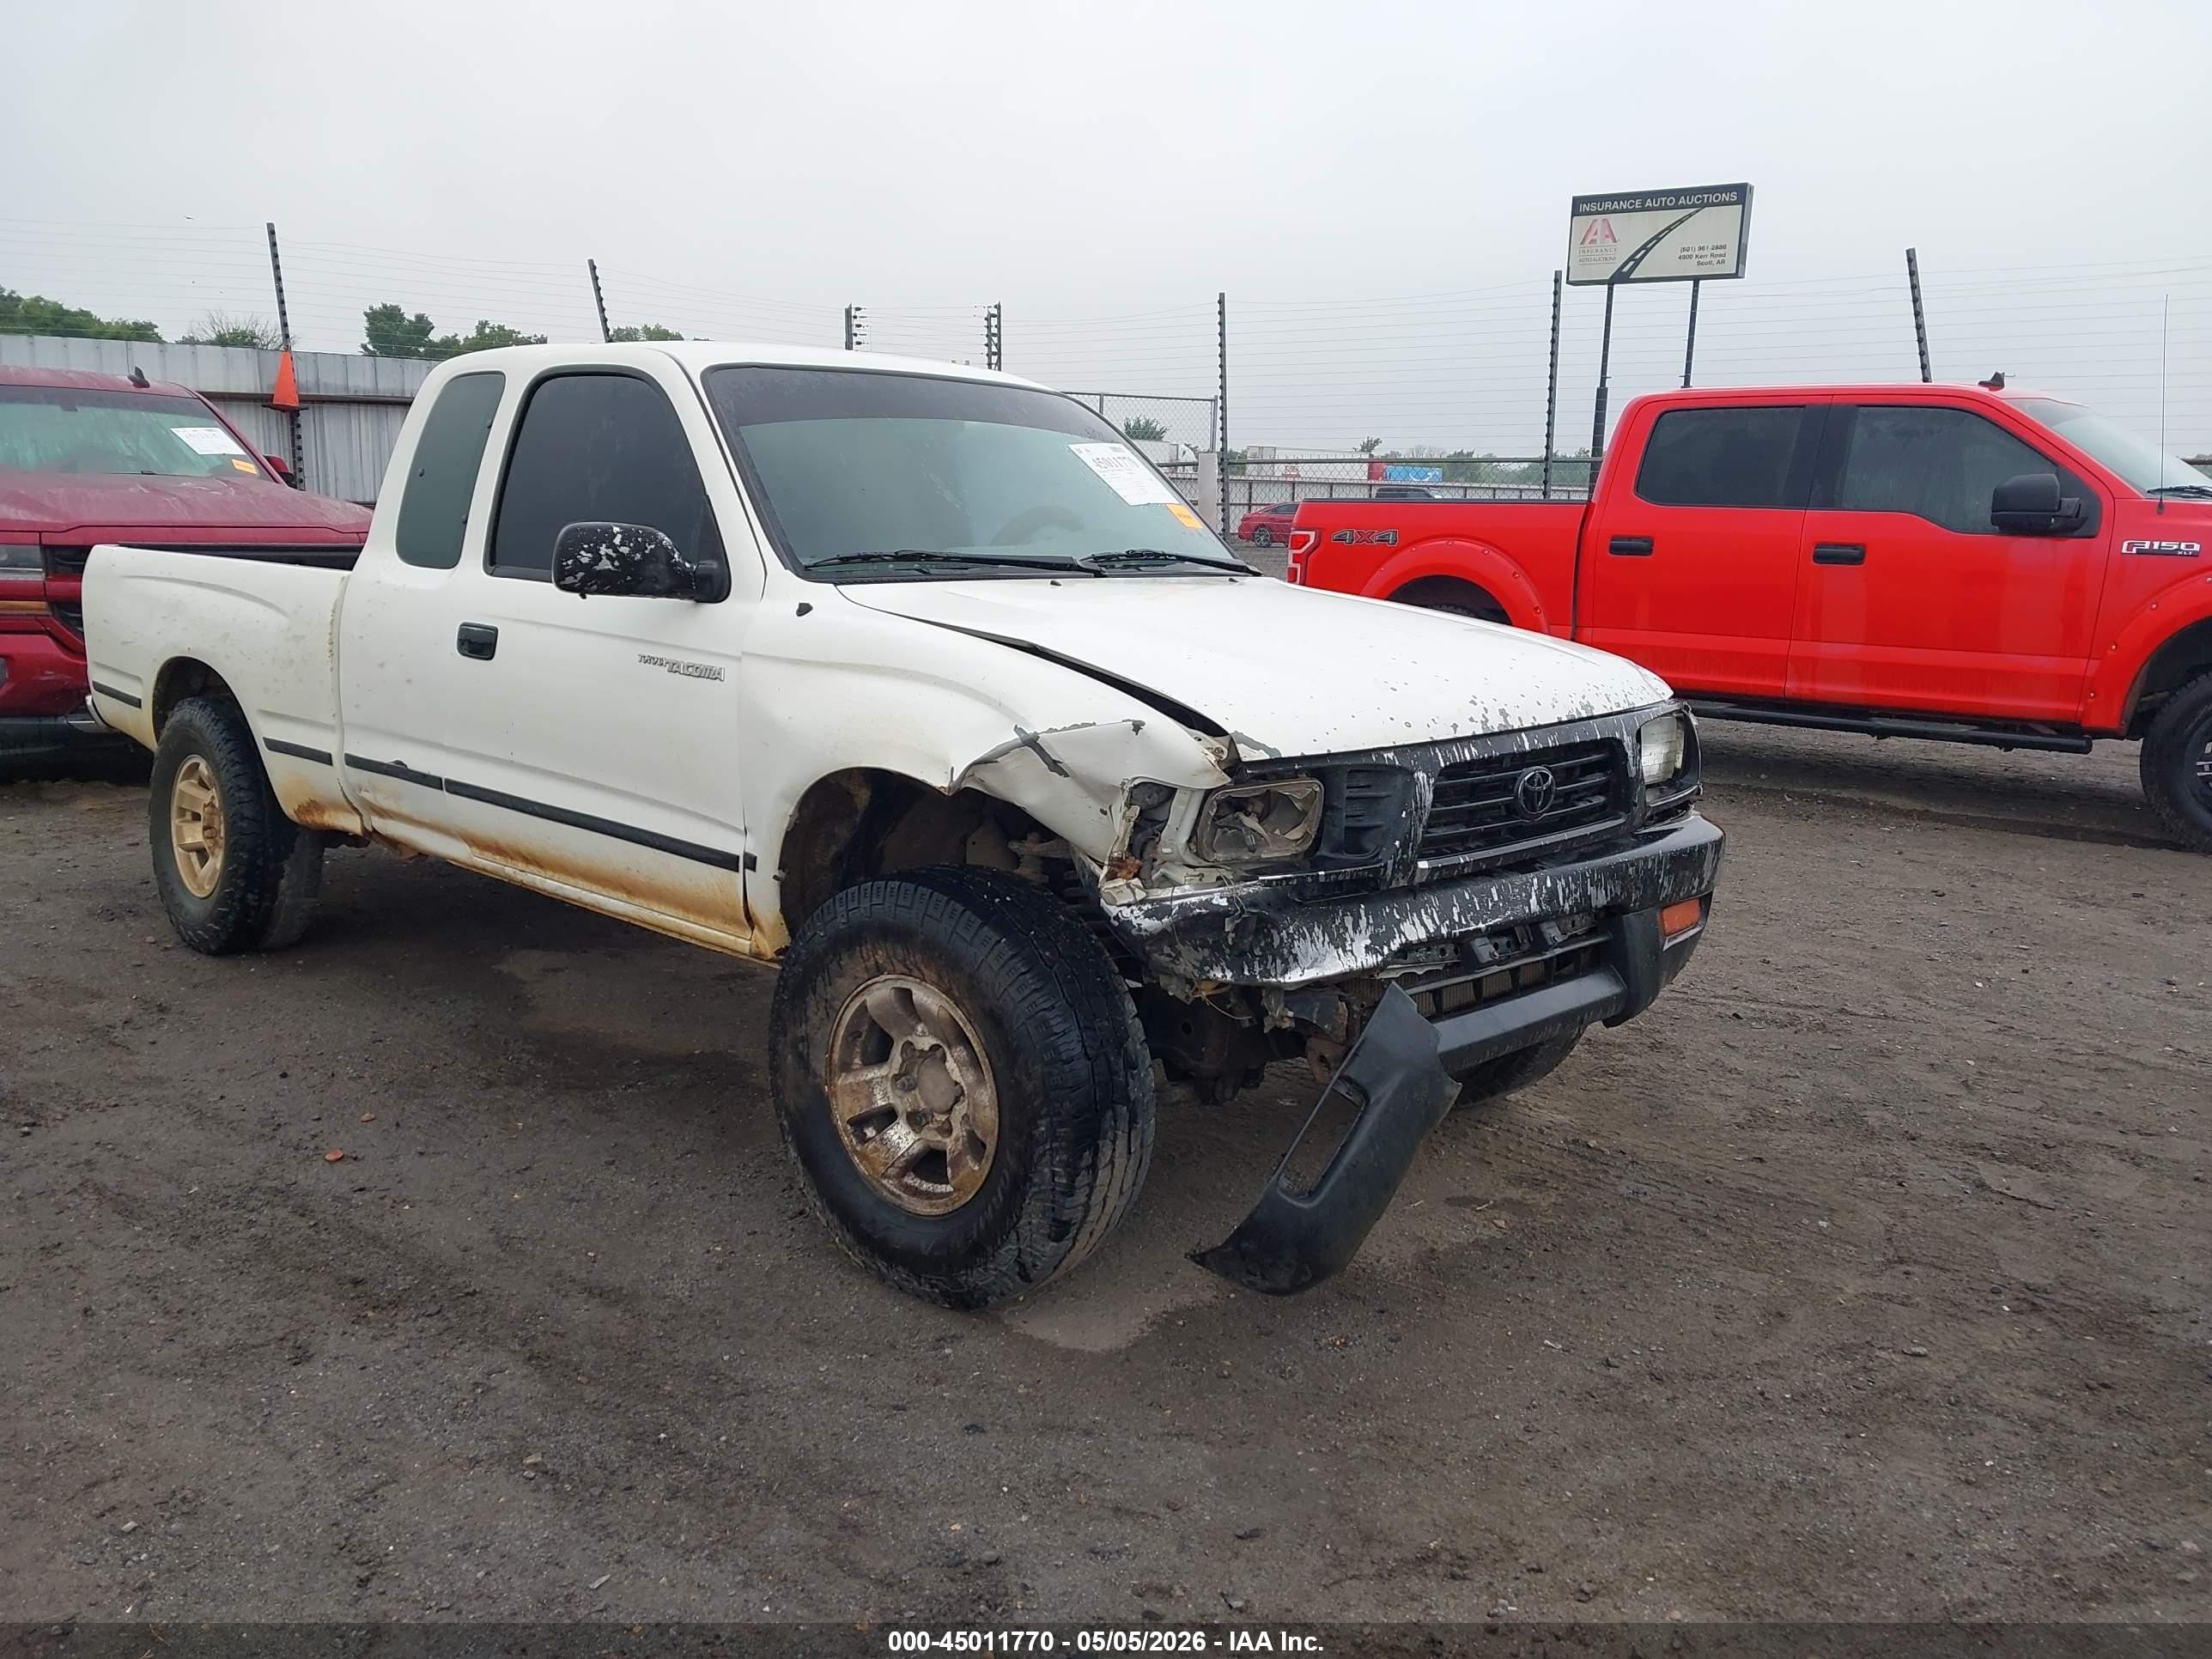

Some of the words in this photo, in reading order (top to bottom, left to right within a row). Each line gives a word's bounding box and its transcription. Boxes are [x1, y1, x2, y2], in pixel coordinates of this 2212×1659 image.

[1579, 199, 1643, 213] INSURANCE
[1644, 197, 1675, 208] AUTO
[1678, 191, 1738, 206] AUCTIONS
[666, 659, 726, 682] TACOMA
